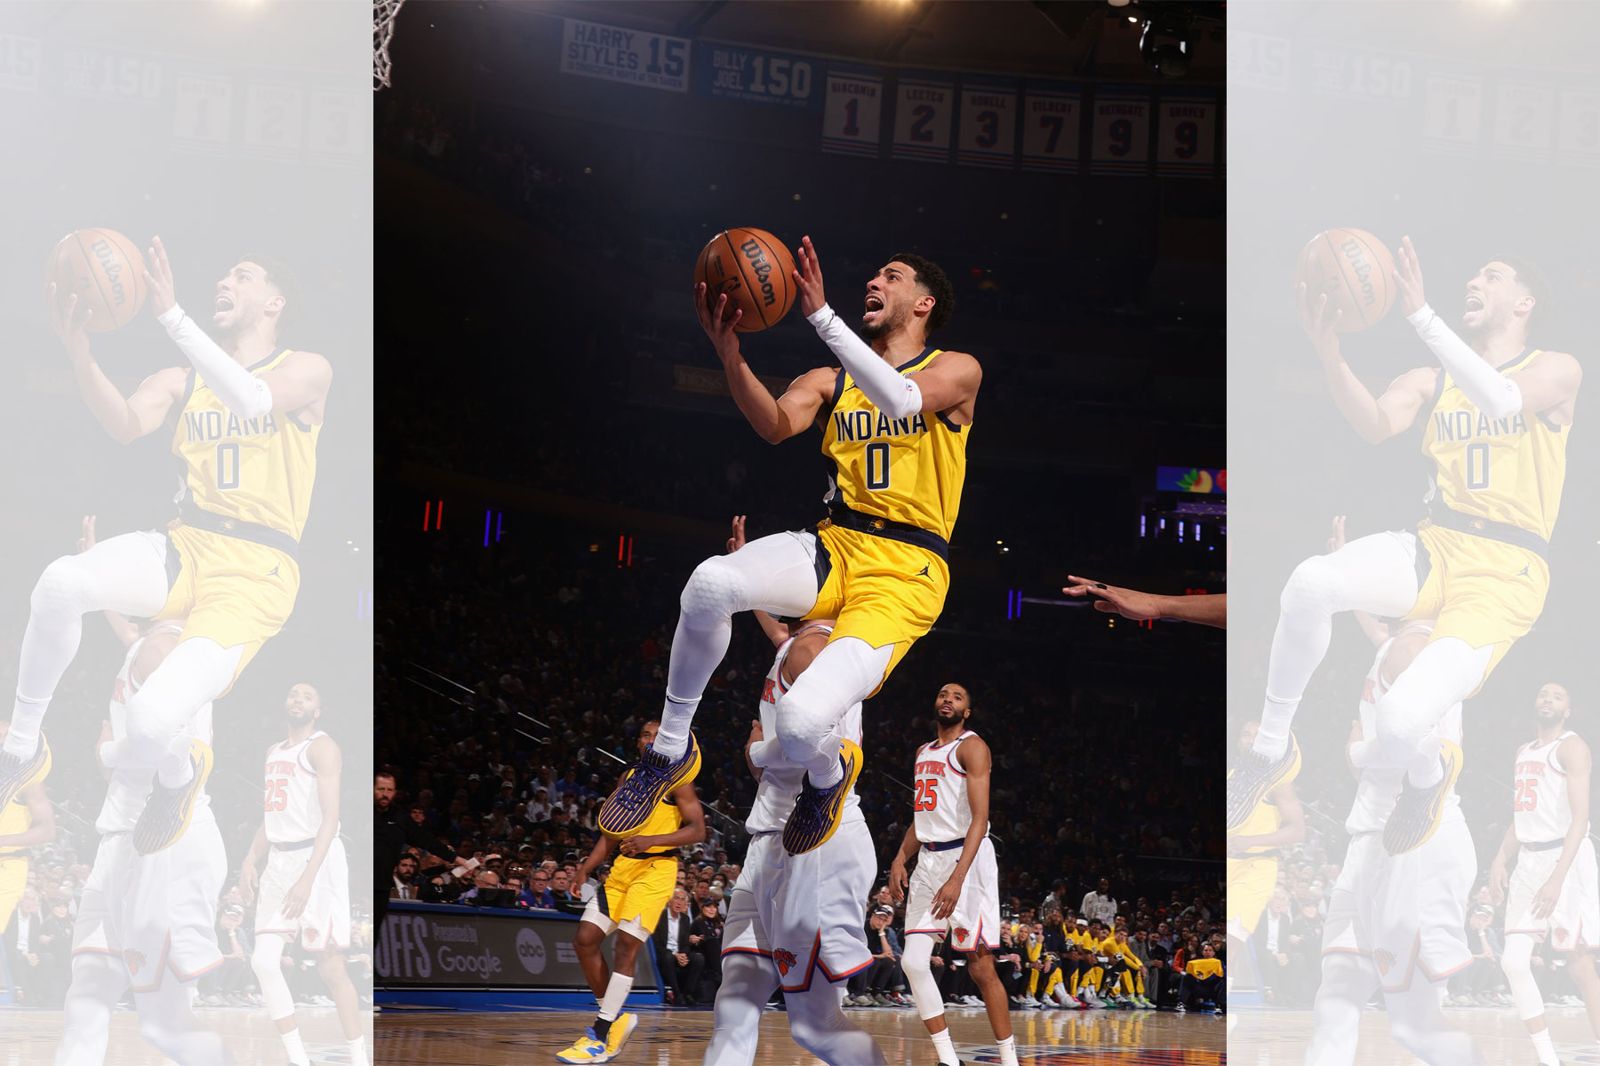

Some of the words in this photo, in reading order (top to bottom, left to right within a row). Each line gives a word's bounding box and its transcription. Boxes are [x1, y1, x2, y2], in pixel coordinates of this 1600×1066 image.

[575, 22, 635, 50] HARRY
[567, 41, 639, 70] STYLES
[646, 37, 685, 77] 15
[712, 49, 748, 71] BILLY
[712, 69, 744, 90] JOEL
[749, 55, 812, 98] 150
[842, 98, 859, 136] 1
[911, 104, 935, 142] 2
[975, 110, 999, 148] 3
[1039, 115, 1064, 153] 7
[1108, 119, 1133, 157] 9
[1174, 120, 1198, 159] 9
[90, 238, 126, 308] Wilson
[740, 238, 776, 308] Wilson
[1340, 238, 1376, 308] Wilson
[183, 409, 279, 442] INDANA
[833, 409, 929, 442] INDANA
[1433, 409, 1529, 442] INDANA
[216, 442, 240, 490] 0
[866, 442, 890, 490] 0
[1466, 442, 1490, 490] 0
[264, 778, 288, 812] 25
[914, 778, 938, 812] 25
[1514, 778, 1538, 812] 25
[437, 945, 502, 980] Google
[519, 942, 544, 957] abc
